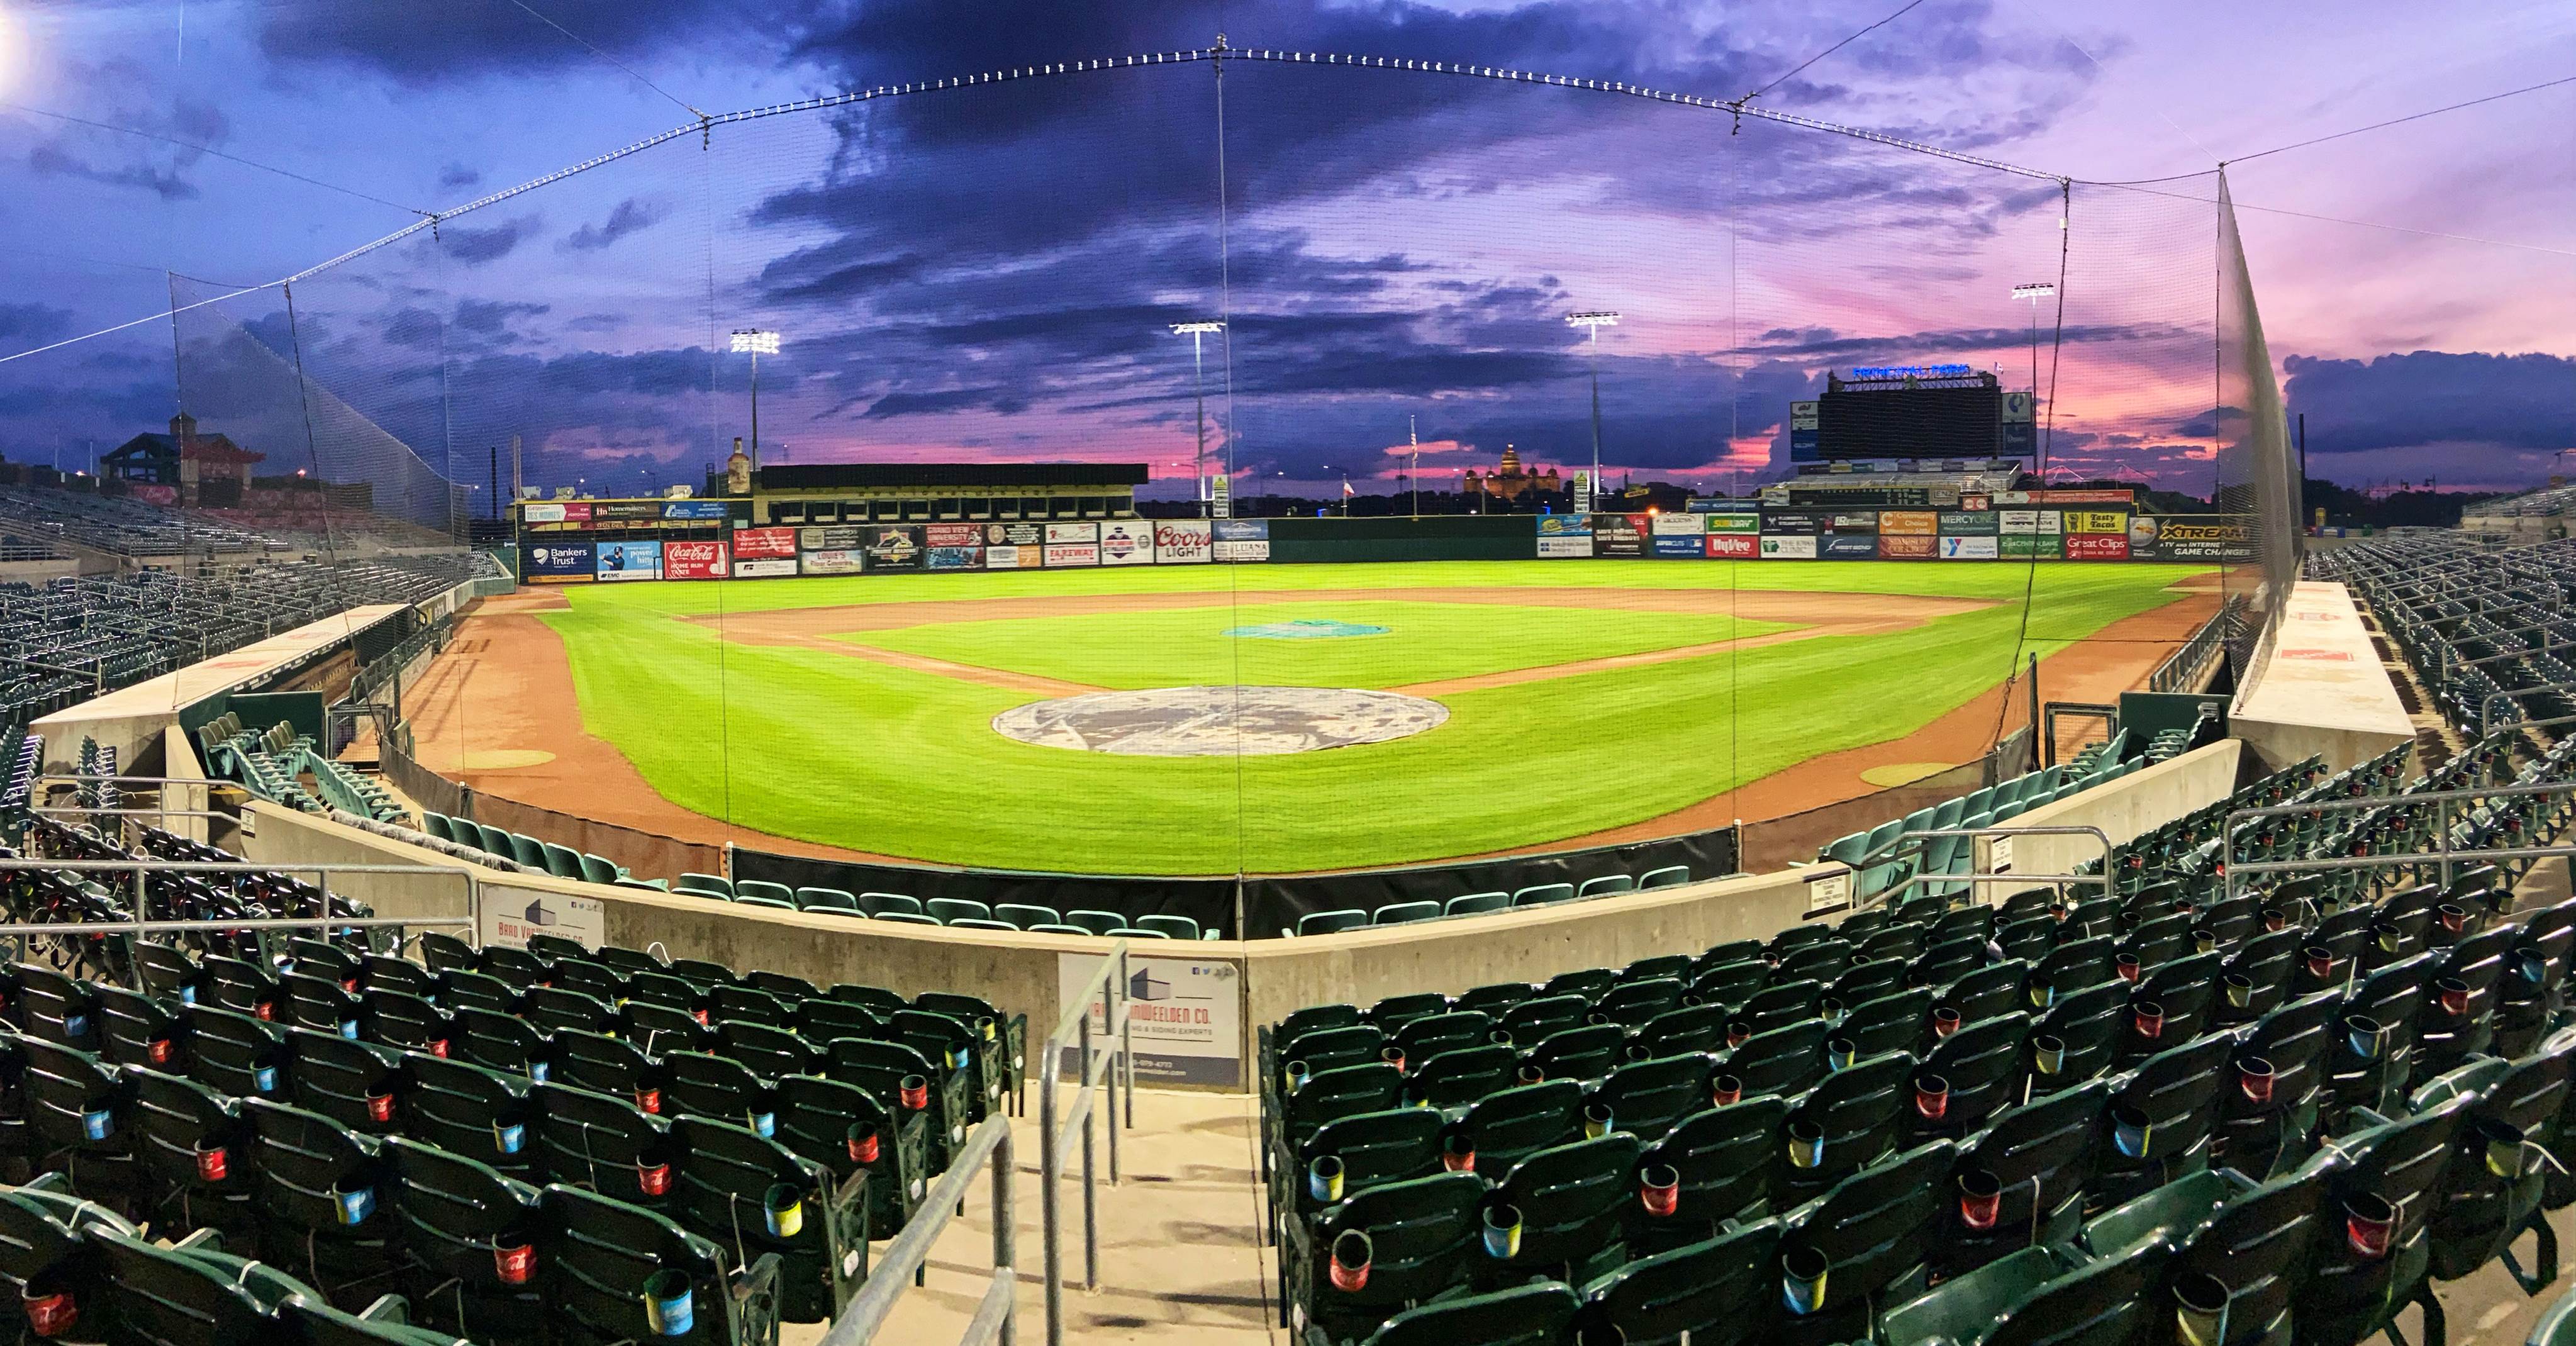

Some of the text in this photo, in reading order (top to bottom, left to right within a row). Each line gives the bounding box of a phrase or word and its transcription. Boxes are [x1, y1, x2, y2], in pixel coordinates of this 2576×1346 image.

[1931, 364, 1968, 374] PARK
[608, 504, 646, 513] Homemakers
[1896, 513, 1934, 521] Community
[2090, 513, 2116, 522] Tasty
[1713, 520, 1754, 528] SUBWAY
[1156, 526, 1211, 547] Coors
[2067, 538, 2125, 551] Great Clips
[552, 548, 588, 558] Bankers
[630, 550, 654, 559] power
[669, 545, 715, 561] Coca-Cola
[1049, 549, 1095, 557] FAREWAY
[1166, 547, 1202, 557] LIGHT
[552, 556, 575, 565] Trust
[1194, 1007, 1212, 1024] CO.
[1152, 1026, 1176, 1035] SIDING
